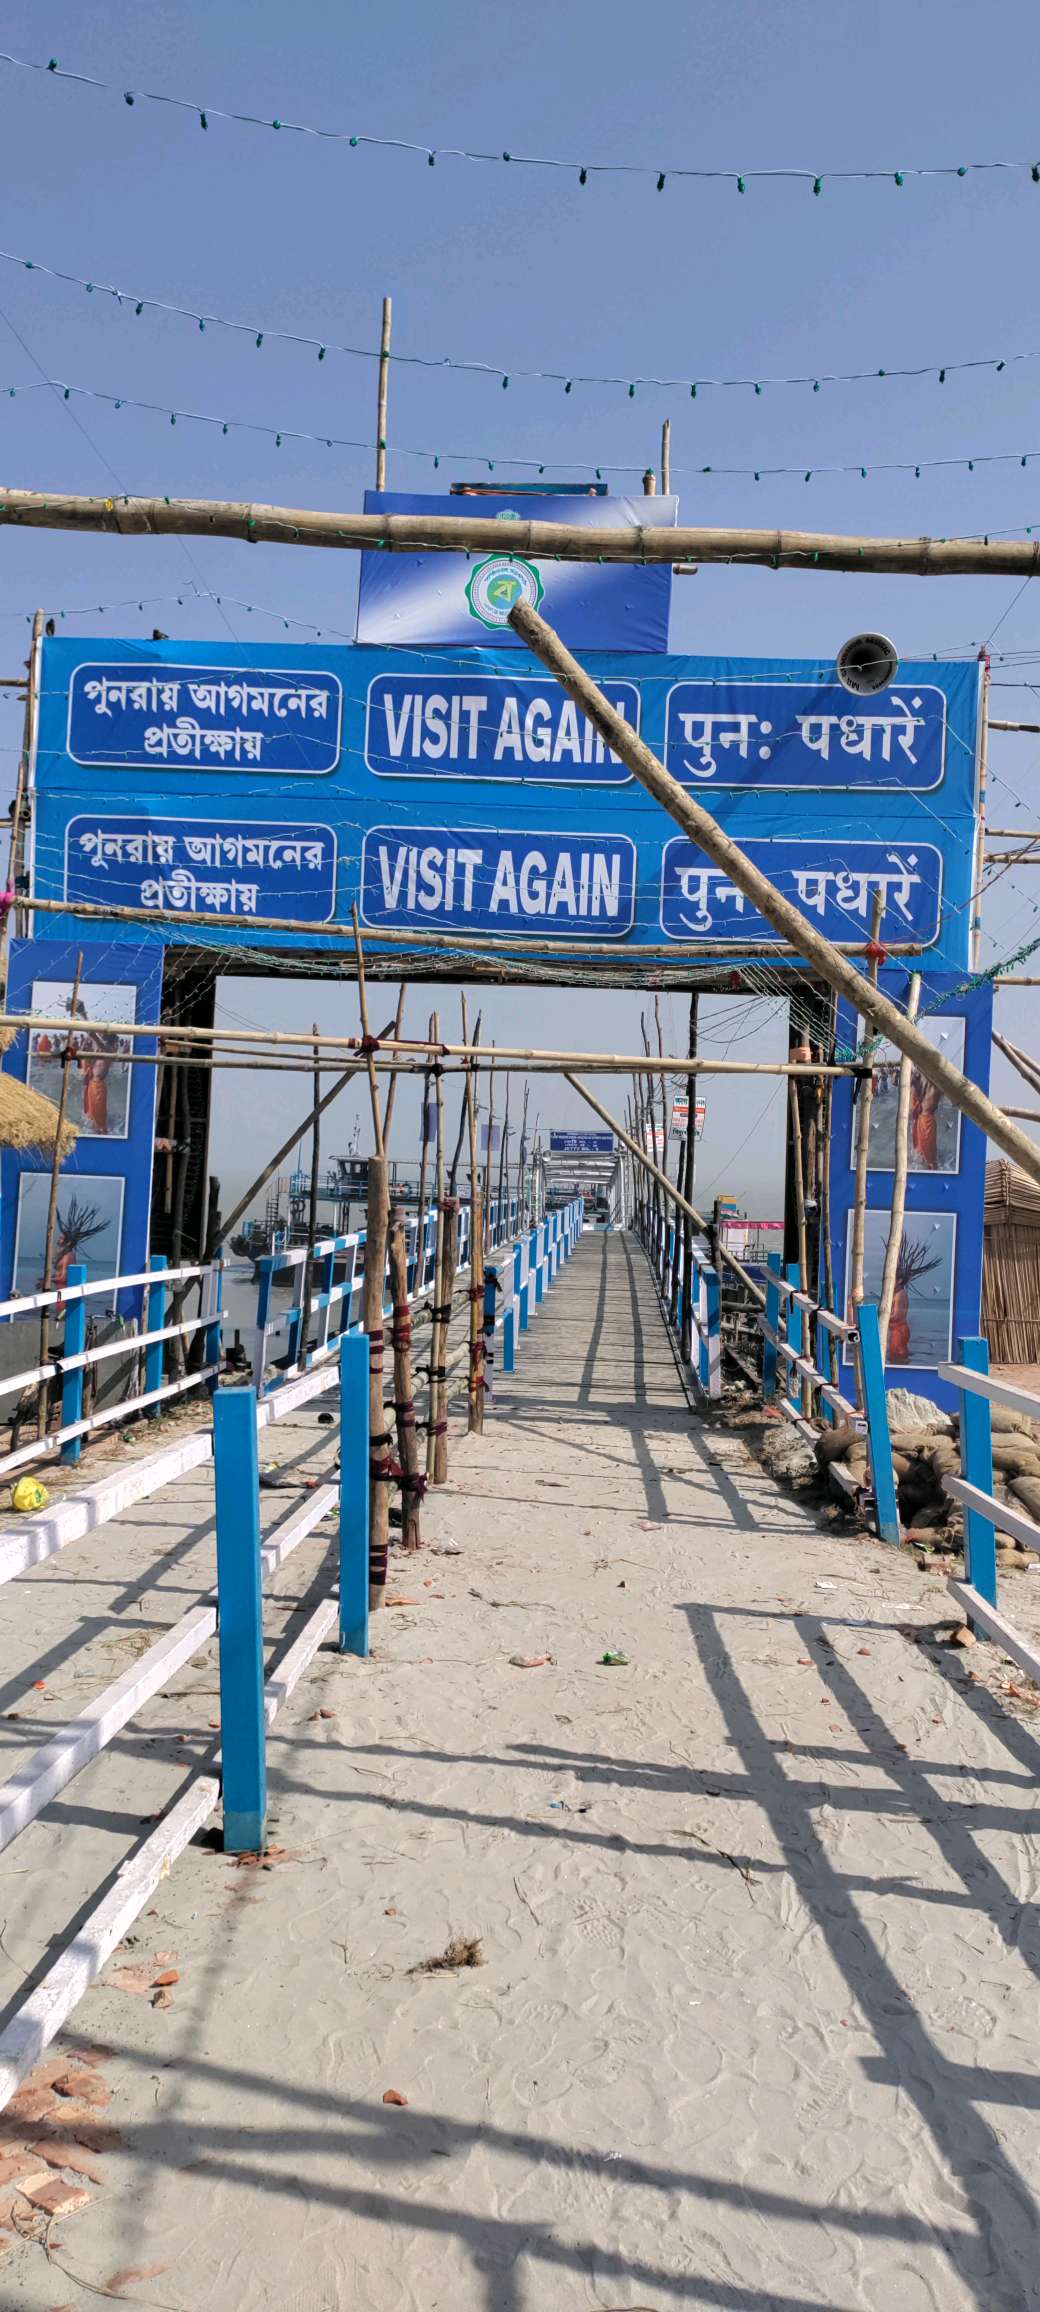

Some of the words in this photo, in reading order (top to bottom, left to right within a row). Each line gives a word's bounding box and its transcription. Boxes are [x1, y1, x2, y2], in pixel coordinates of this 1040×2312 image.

[84, 677, 181, 717] পুনরায়
[187, 680, 331, 720] আগমনের
[144, 716, 264, 761] প্রতীক্ষায়
[384, 693, 487, 759] VISIT
[494, 696, 625, 764] AGAIN
[795, 696, 926, 764] पधारें
[79, 829, 176, 870] পুনরায়
[183, 833, 325, 871] আগমনের
[141, 869, 260, 913] প্রতীক্ষায়
[378, 845, 482, 912] VISIT
[488, 850, 621, 917] AGAIN
[674, 867, 762, 932] पुन
[791, 852, 922, 921] पधारें
